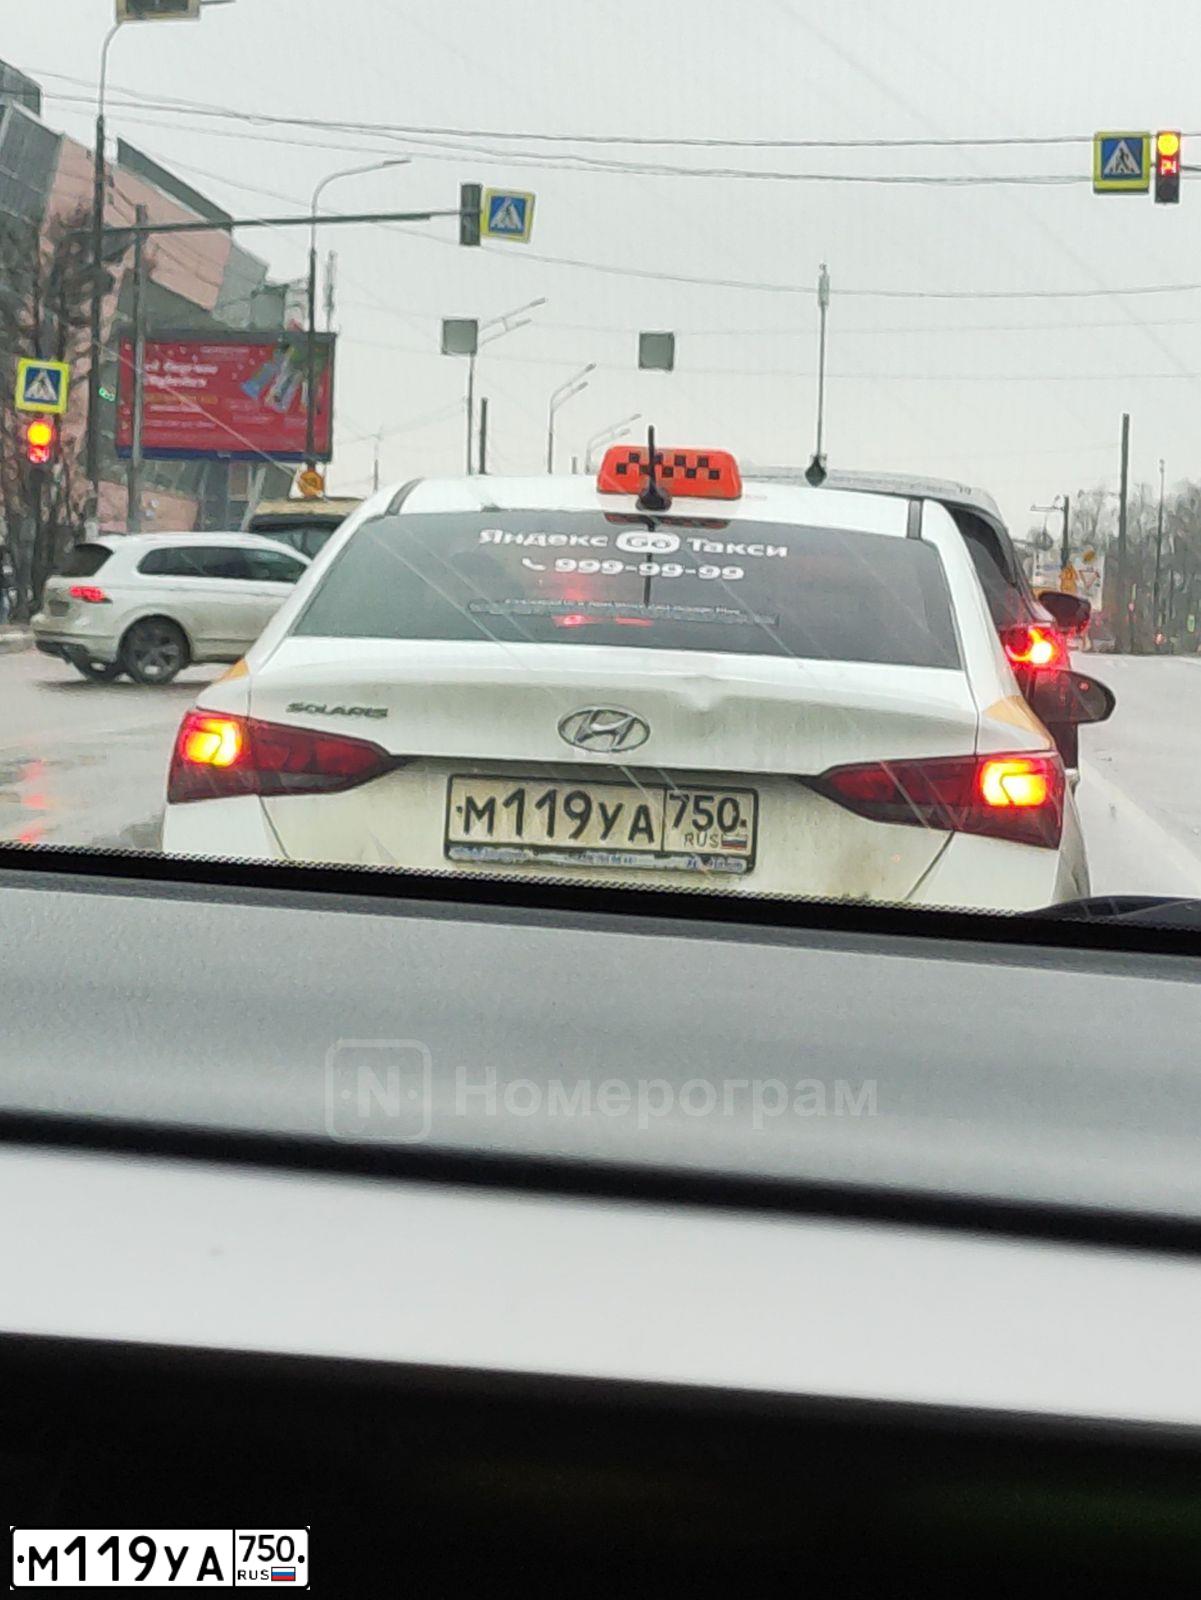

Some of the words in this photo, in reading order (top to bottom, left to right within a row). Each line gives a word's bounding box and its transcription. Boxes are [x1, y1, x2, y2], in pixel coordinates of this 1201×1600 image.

[478, 528, 608, 548] Яндекс
[687, 536, 789, 557] Такси
[554, 557, 744, 580] 999-99-99
[286, 702, 389, 719] SOLARIS
[668, 792, 742, 832] 750
[683, 833, 719, 847] RUS
